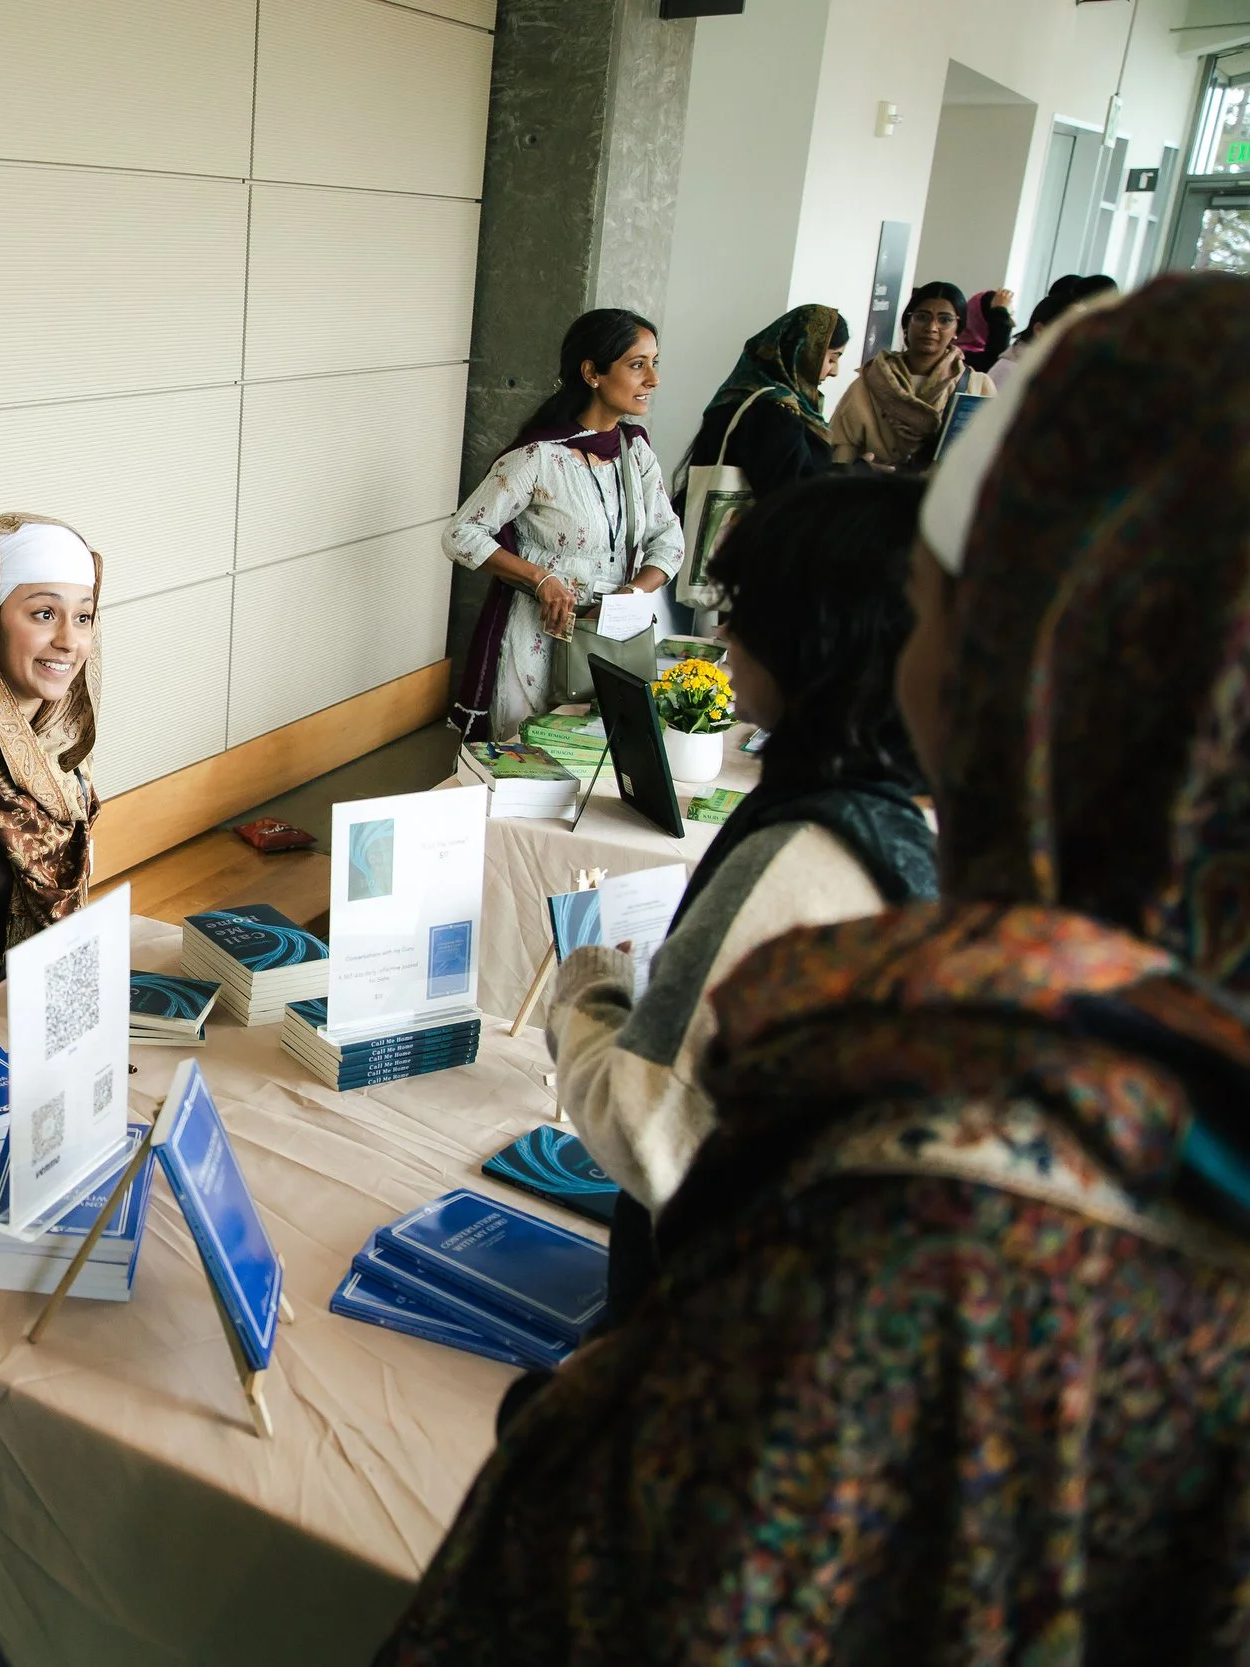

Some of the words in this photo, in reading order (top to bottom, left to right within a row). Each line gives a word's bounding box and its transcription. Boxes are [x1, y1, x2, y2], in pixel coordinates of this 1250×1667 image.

[206, 915, 261, 928] Home
[215, 926, 245, 936] Me
[223, 932, 266, 944] Call
[372, 1048, 386, 1056] Call
[440, 1212, 501, 1249] CONVERSATIONS
[474, 1229, 488, 1238] MY
